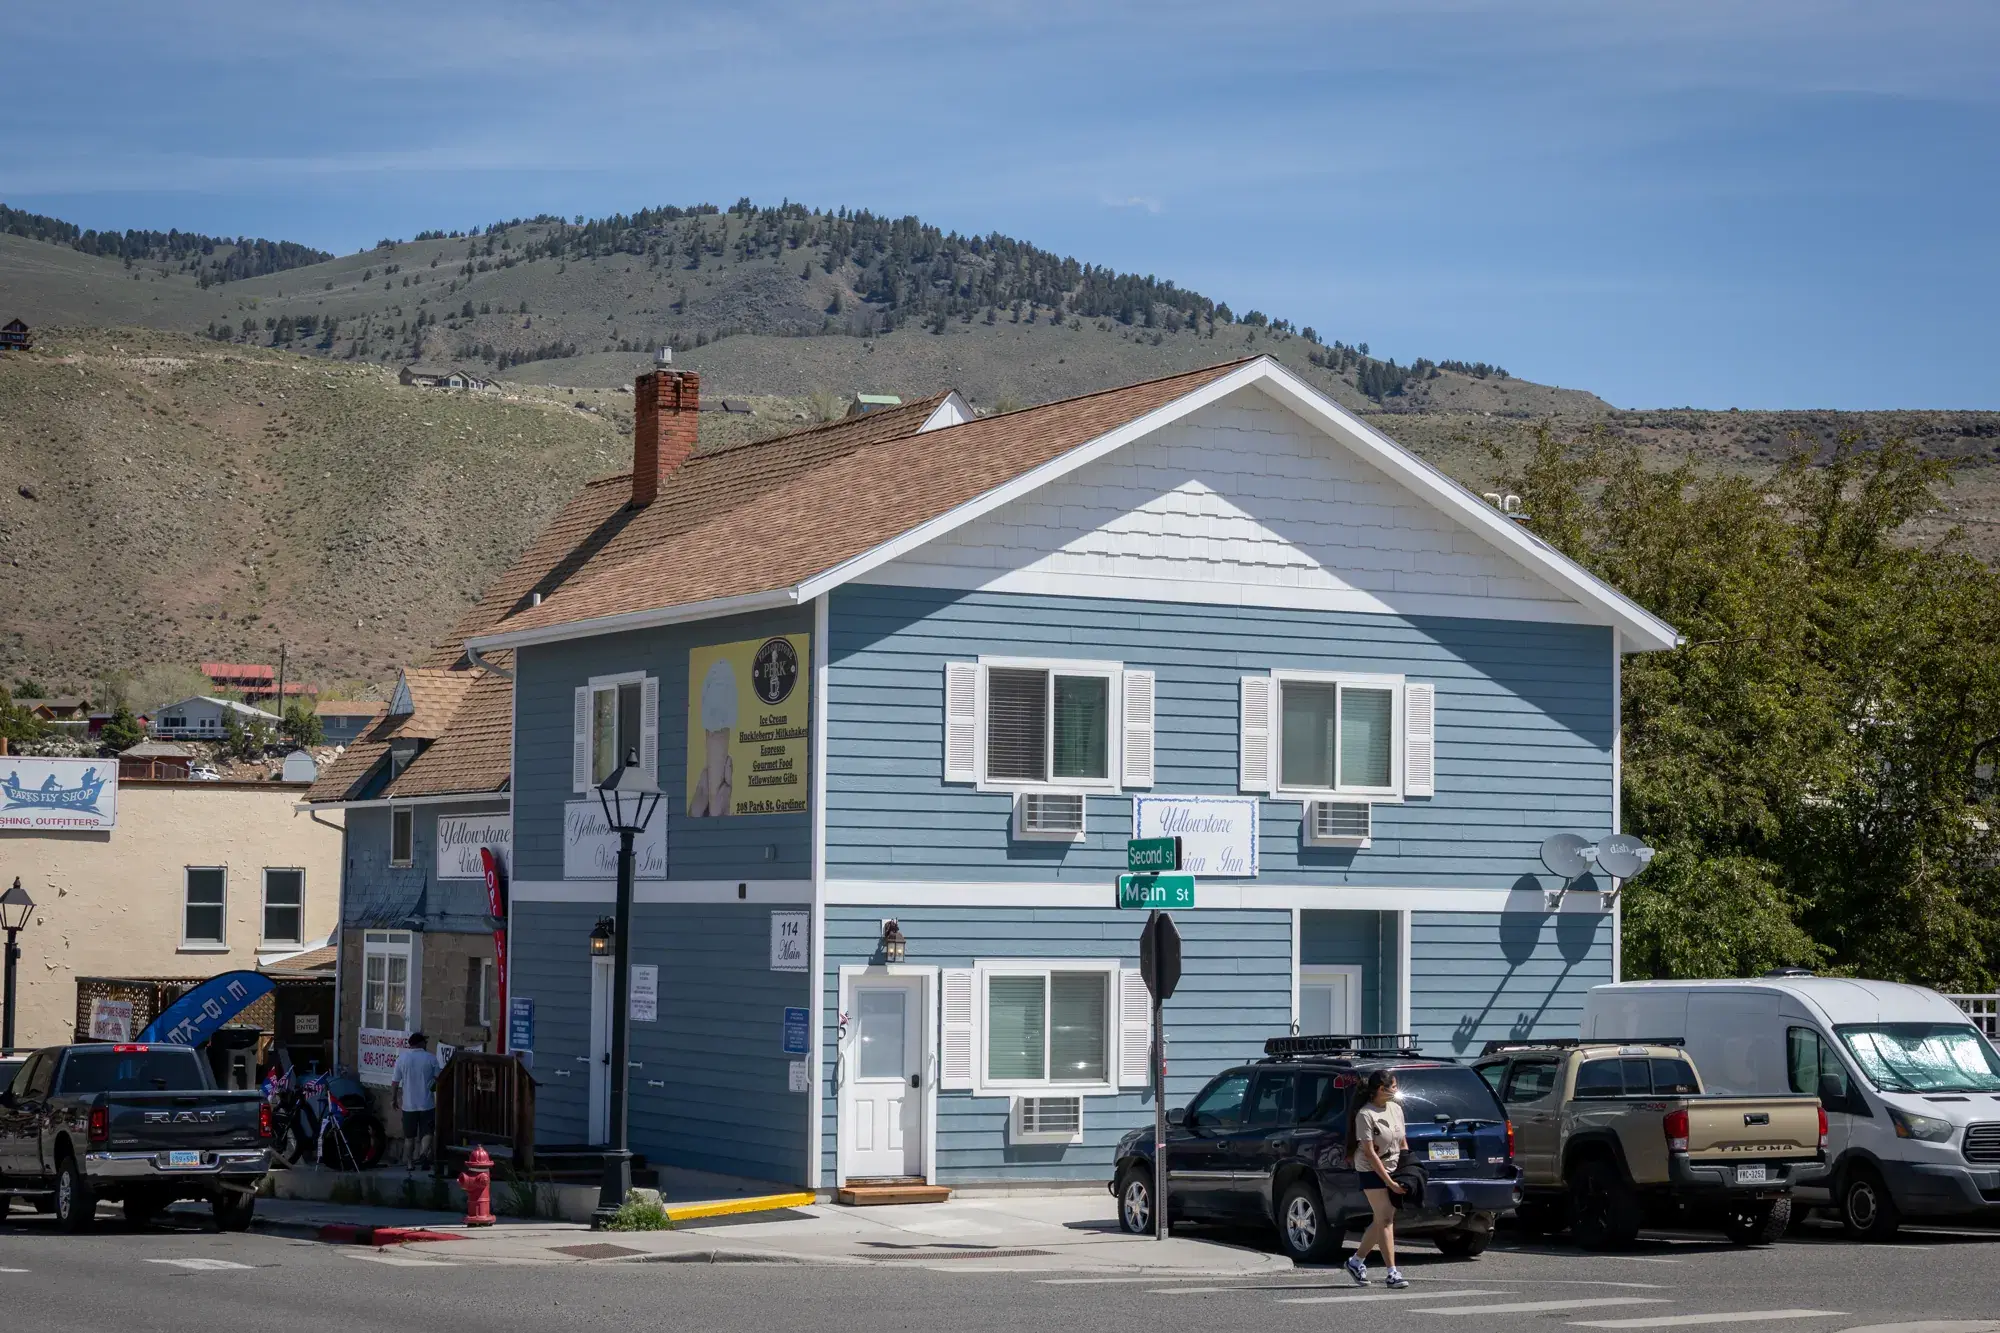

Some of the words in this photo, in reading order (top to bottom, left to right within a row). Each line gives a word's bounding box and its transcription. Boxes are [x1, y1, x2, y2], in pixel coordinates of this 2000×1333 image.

[763, 661, 787, 678] PERK
[760, 715, 768, 725] Ice
[769, 714, 787, 724] Cream
[739, 731, 774, 742] Huckleberry
[760, 744, 785, 755] Espresso
[753, 760, 778, 770] Gourmet
[779, 758, 793, 768] Food
[748, 774, 782, 785] Yellowstone
[783, 773, 797, 783] Gifts
[10, 789, 39, 803] PARKS
[41, 793, 59, 802] FLY
[61, 788, 94, 802] SHOP
[749, 800, 764, 811] Park
[775, 798, 806, 810] Gardiner
[36, 817, 99, 826] OUTFITTERS
[1160, 805, 1233, 837] Yellowstone
[440, 820, 510, 853] Yellowstone
[1130, 846, 1162, 865] Second
[1165, 851, 1173, 864] St
[1610, 843, 1629, 854] dish
[1216, 845, 1243, 872] Inn
[1125, 883, 1166, 901] Main
[1176, 888, 1189, 901] St
[781, 921, 798, 936] 114
[777, 938, 801, 960] Main
[1291, 1018, 1300, 1036] 6
[144, 1110, 226, 1124] RAM
[1718, 1144, 1793, 1152] TACOMA
